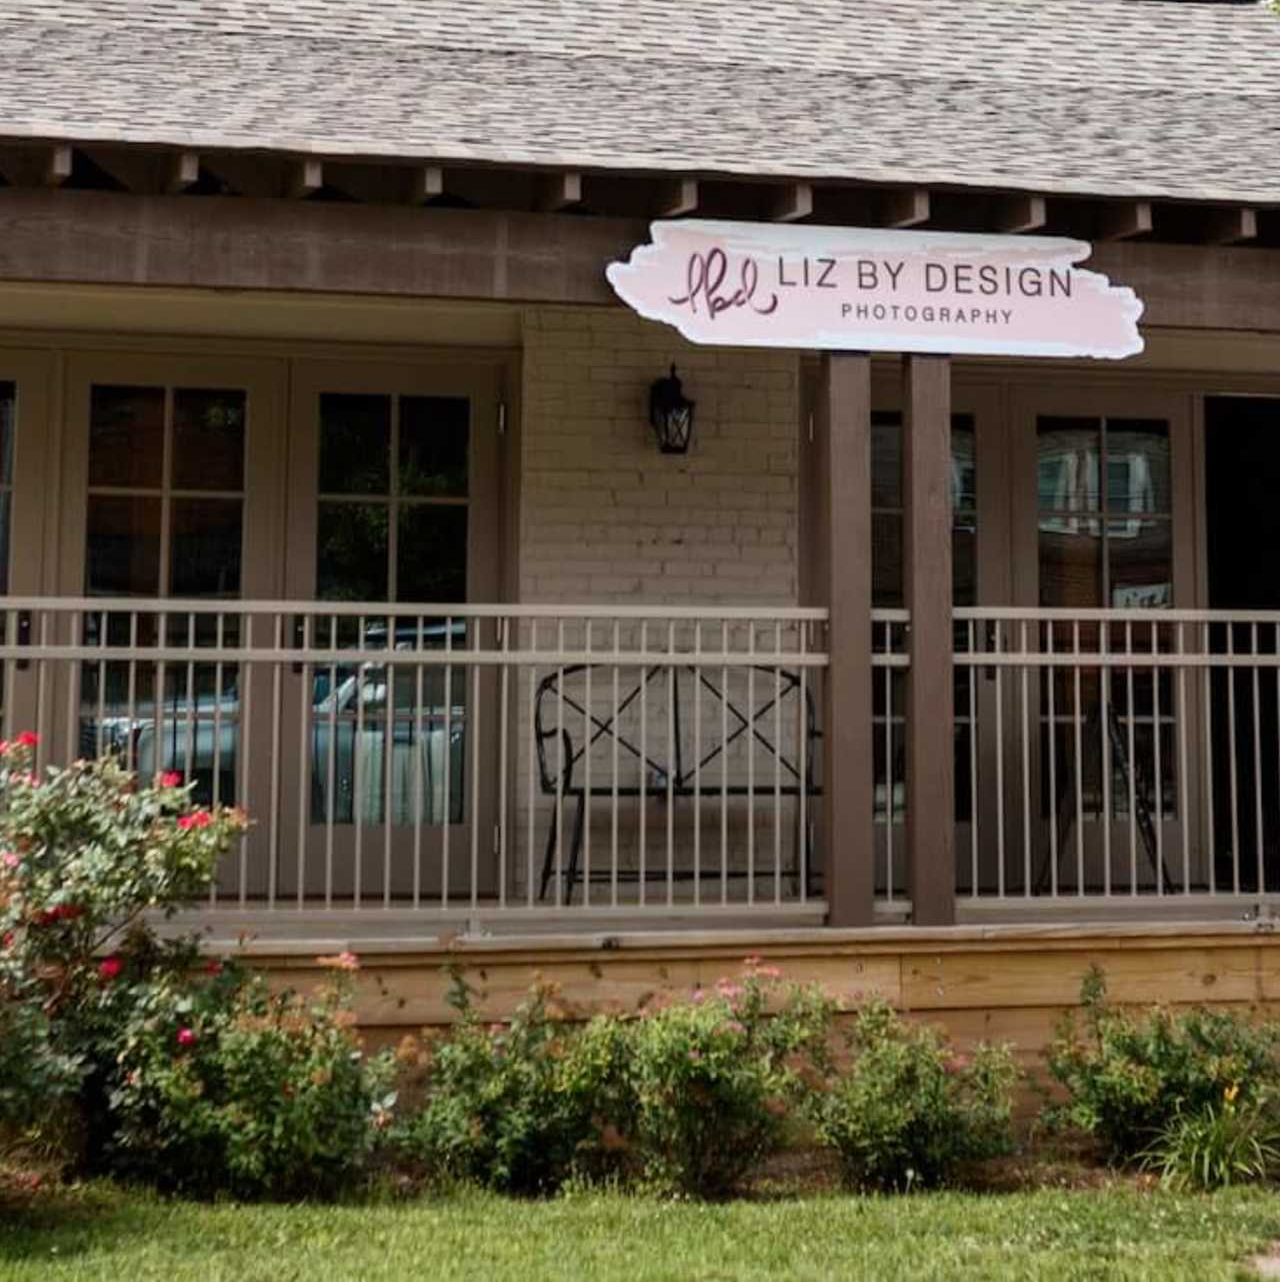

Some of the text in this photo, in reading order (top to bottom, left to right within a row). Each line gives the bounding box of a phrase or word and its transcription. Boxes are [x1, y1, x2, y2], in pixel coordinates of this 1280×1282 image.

[778, 256, 1072, 298] LIZ BY DESIGN
[841, 303, 1013, 325] PHOTOGRAPHY
